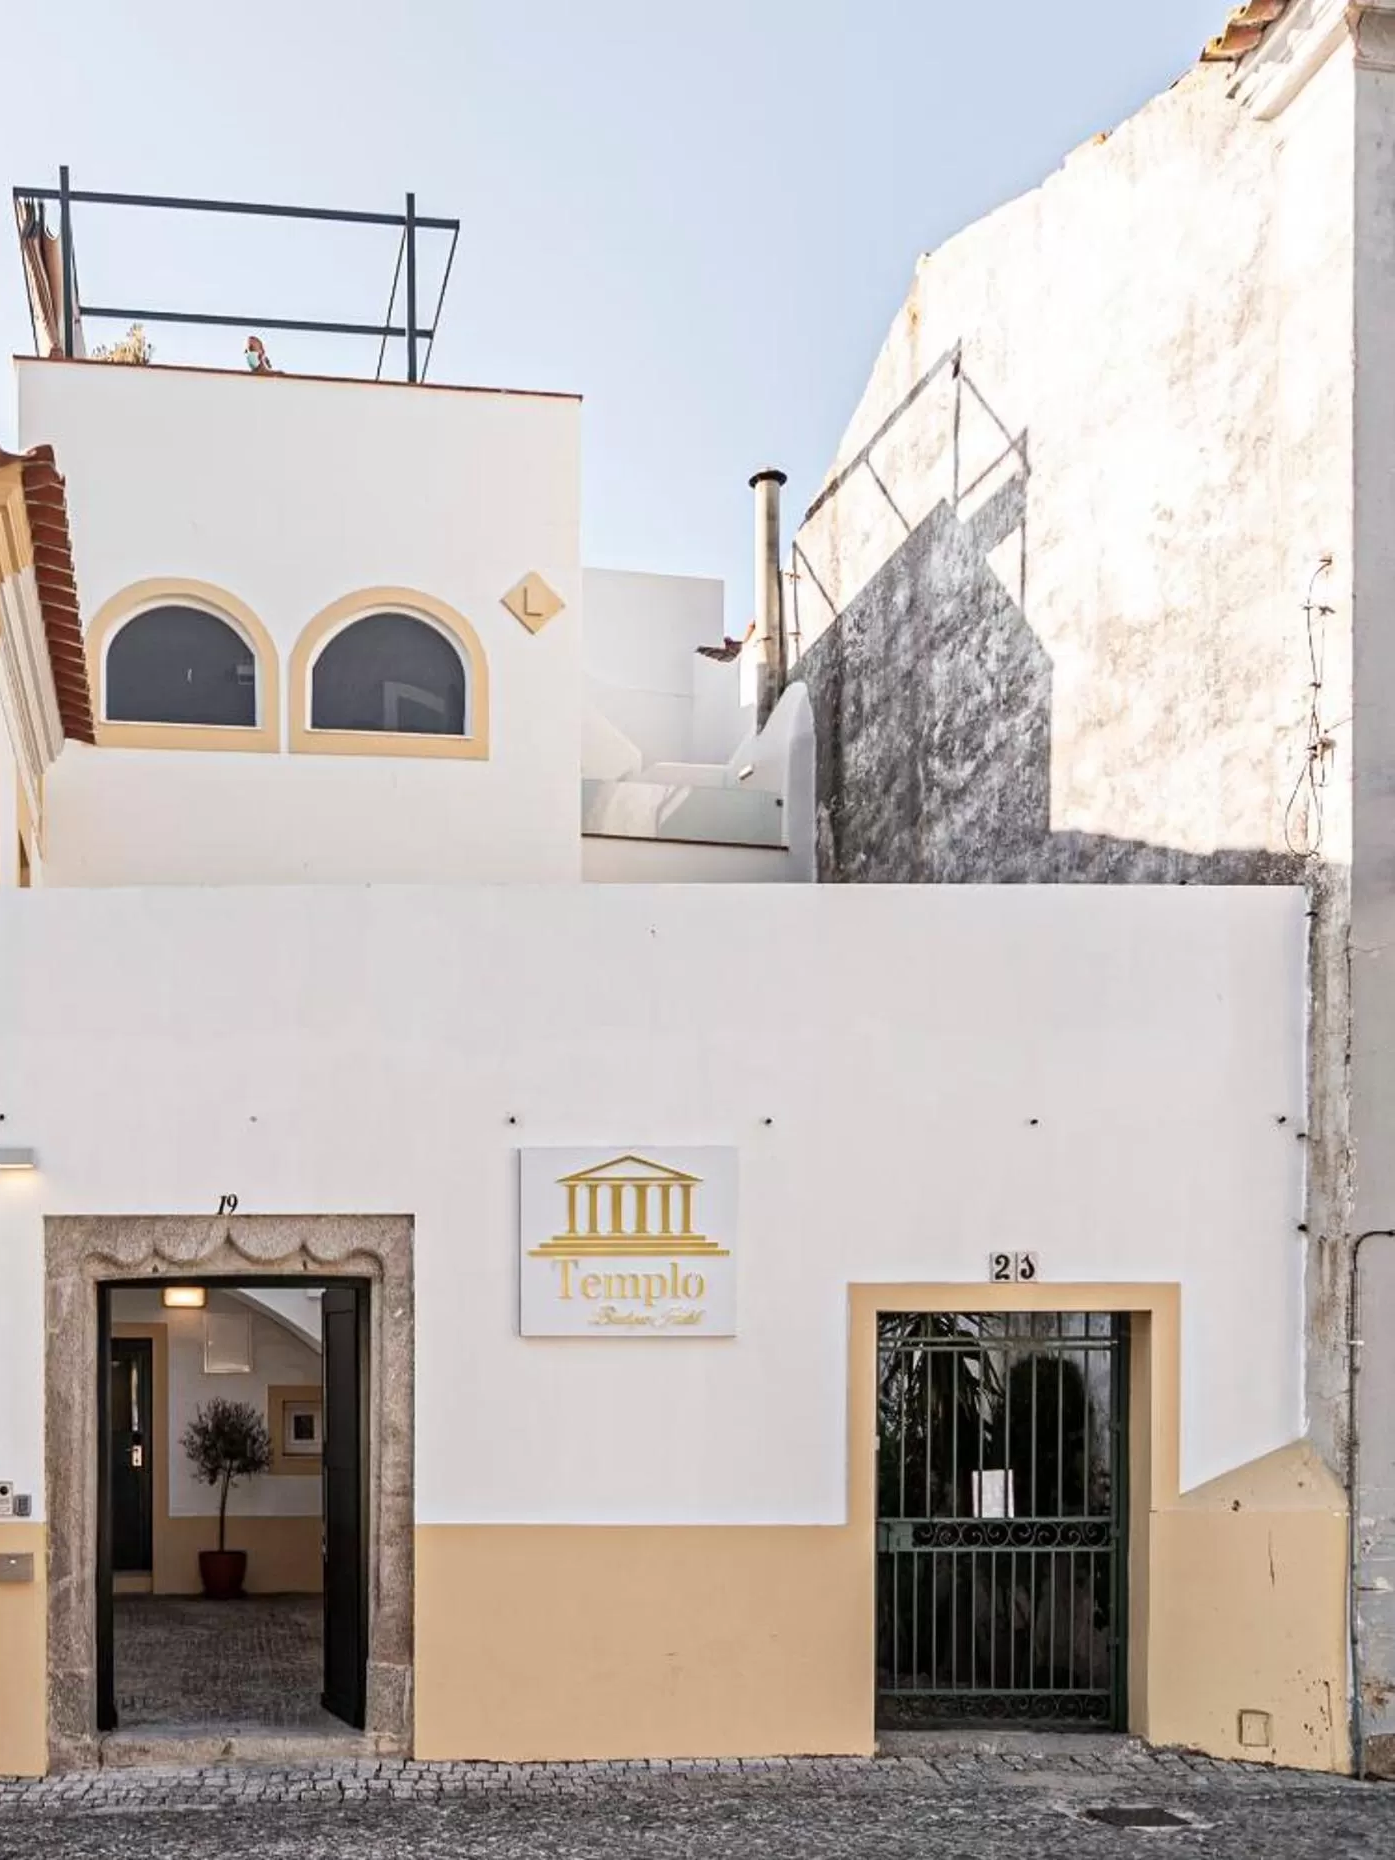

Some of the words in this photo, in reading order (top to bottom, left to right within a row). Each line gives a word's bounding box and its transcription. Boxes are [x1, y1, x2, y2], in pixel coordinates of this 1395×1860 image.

[523, 586, 543, 616] L
[217, 1193, 239, 1215] 19
[551, 1258, 705, 1306] Templo
